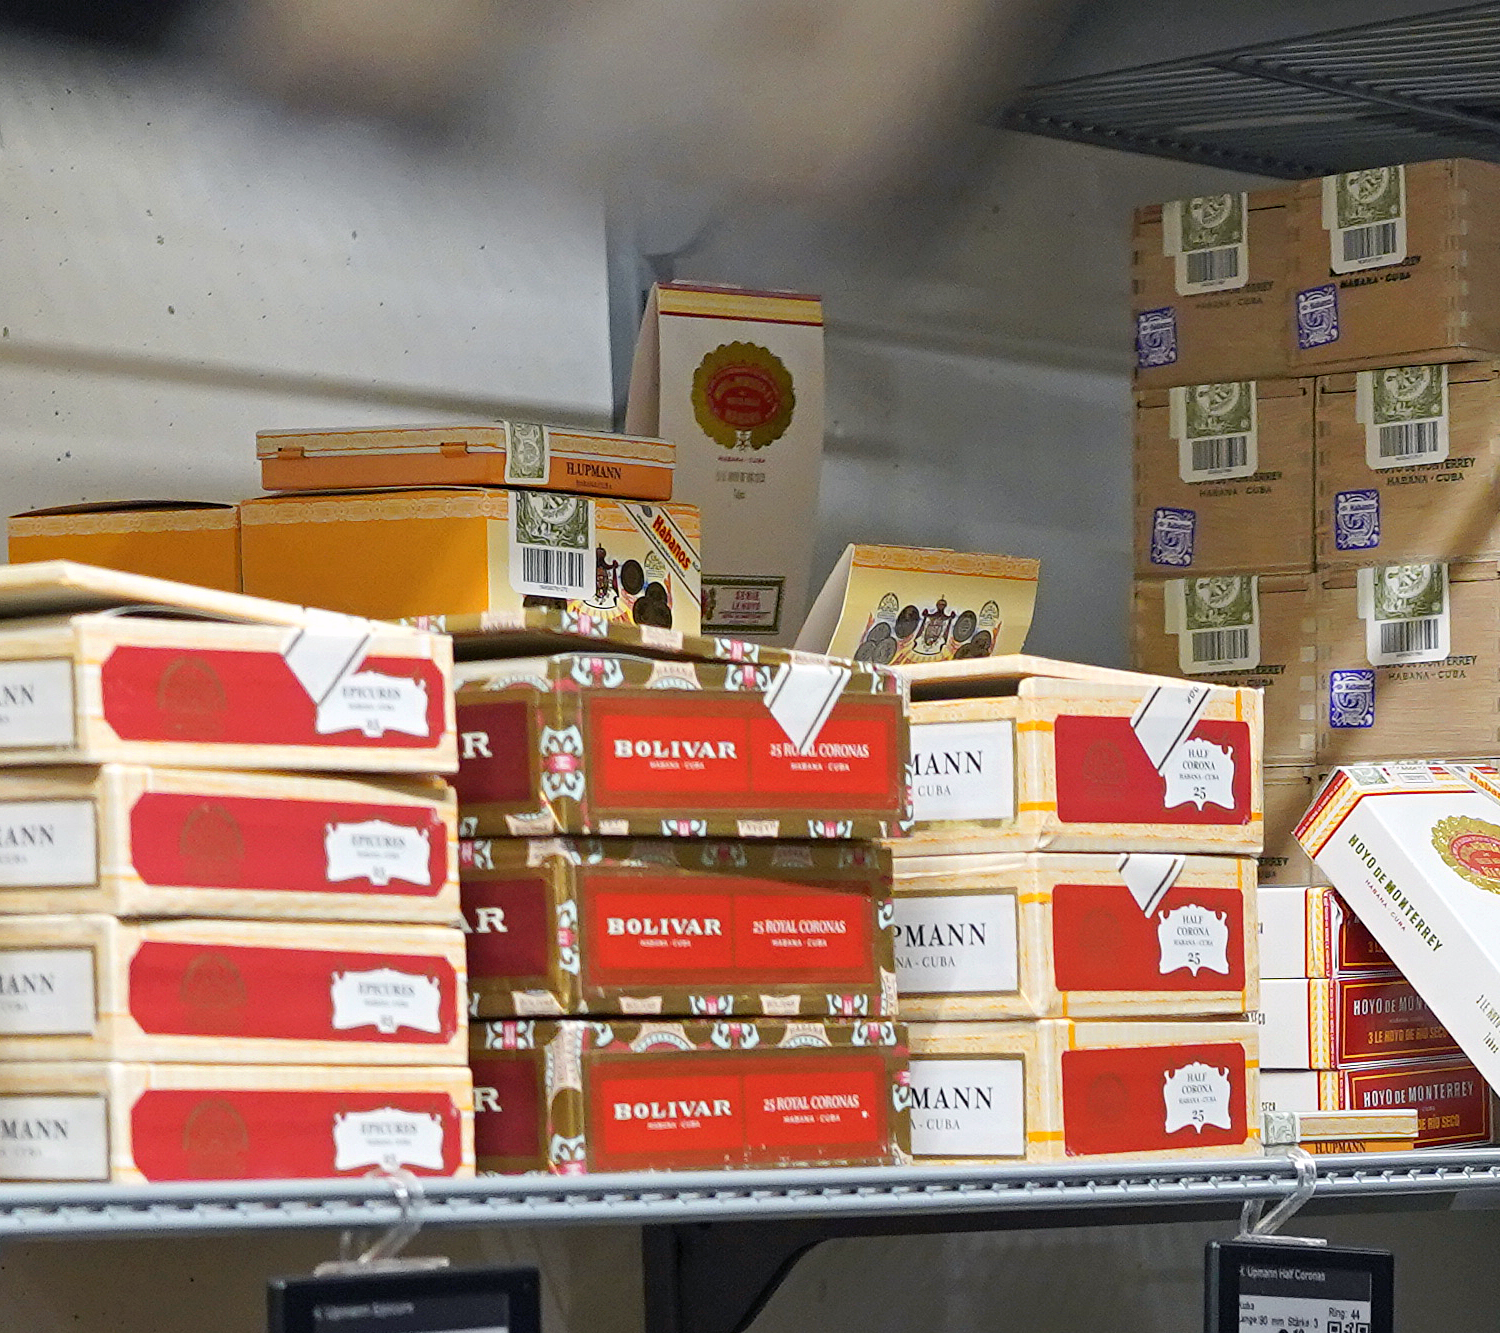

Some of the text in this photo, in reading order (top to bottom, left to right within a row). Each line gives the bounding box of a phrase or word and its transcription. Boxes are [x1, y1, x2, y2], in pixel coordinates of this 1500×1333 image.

[651, 513, 693, 572] Habanos
[614, 739, 738, 760] BOLIVAR
[819, 744, 869, 759] CORONAS
[1188, 748, 1211, 759] HALF
[1182, 760, 1216, 772] CORONA
[1192, 786, 1207, 799] 25
[1347, 833, 1444, 953] HOYO DE MONTERREY
[1182, 914, 1205, 925] HALF
[606, 917, 723, 938] BOLIVAR
[753, 920, 846, 936] 25 ROYAL CORONAS
[1176, 926, 1211, 938] CORONA
[1187, 952, 1202, 966] 25
[1353, 998, 1395, 1016] HOYO DE
[1186, 1073, 1209, 1084] HALF
[1180, 1084, 1214, 1096] CORONA
[1363, 1081, 1474, 1108] HOYO DE MONTERREY
[614, 1100, 732, 1120] BOLIVAR
[763, 1095, 859, 1112] 25 ROYAL CORONAS
[1190, 1110, 1205, 1123] 25
[1279, 1269, 1294, 1279] Half
[1294, 1269, 1325, 1282] Coronas
[1351, 1309, 1360, 1320] 44
